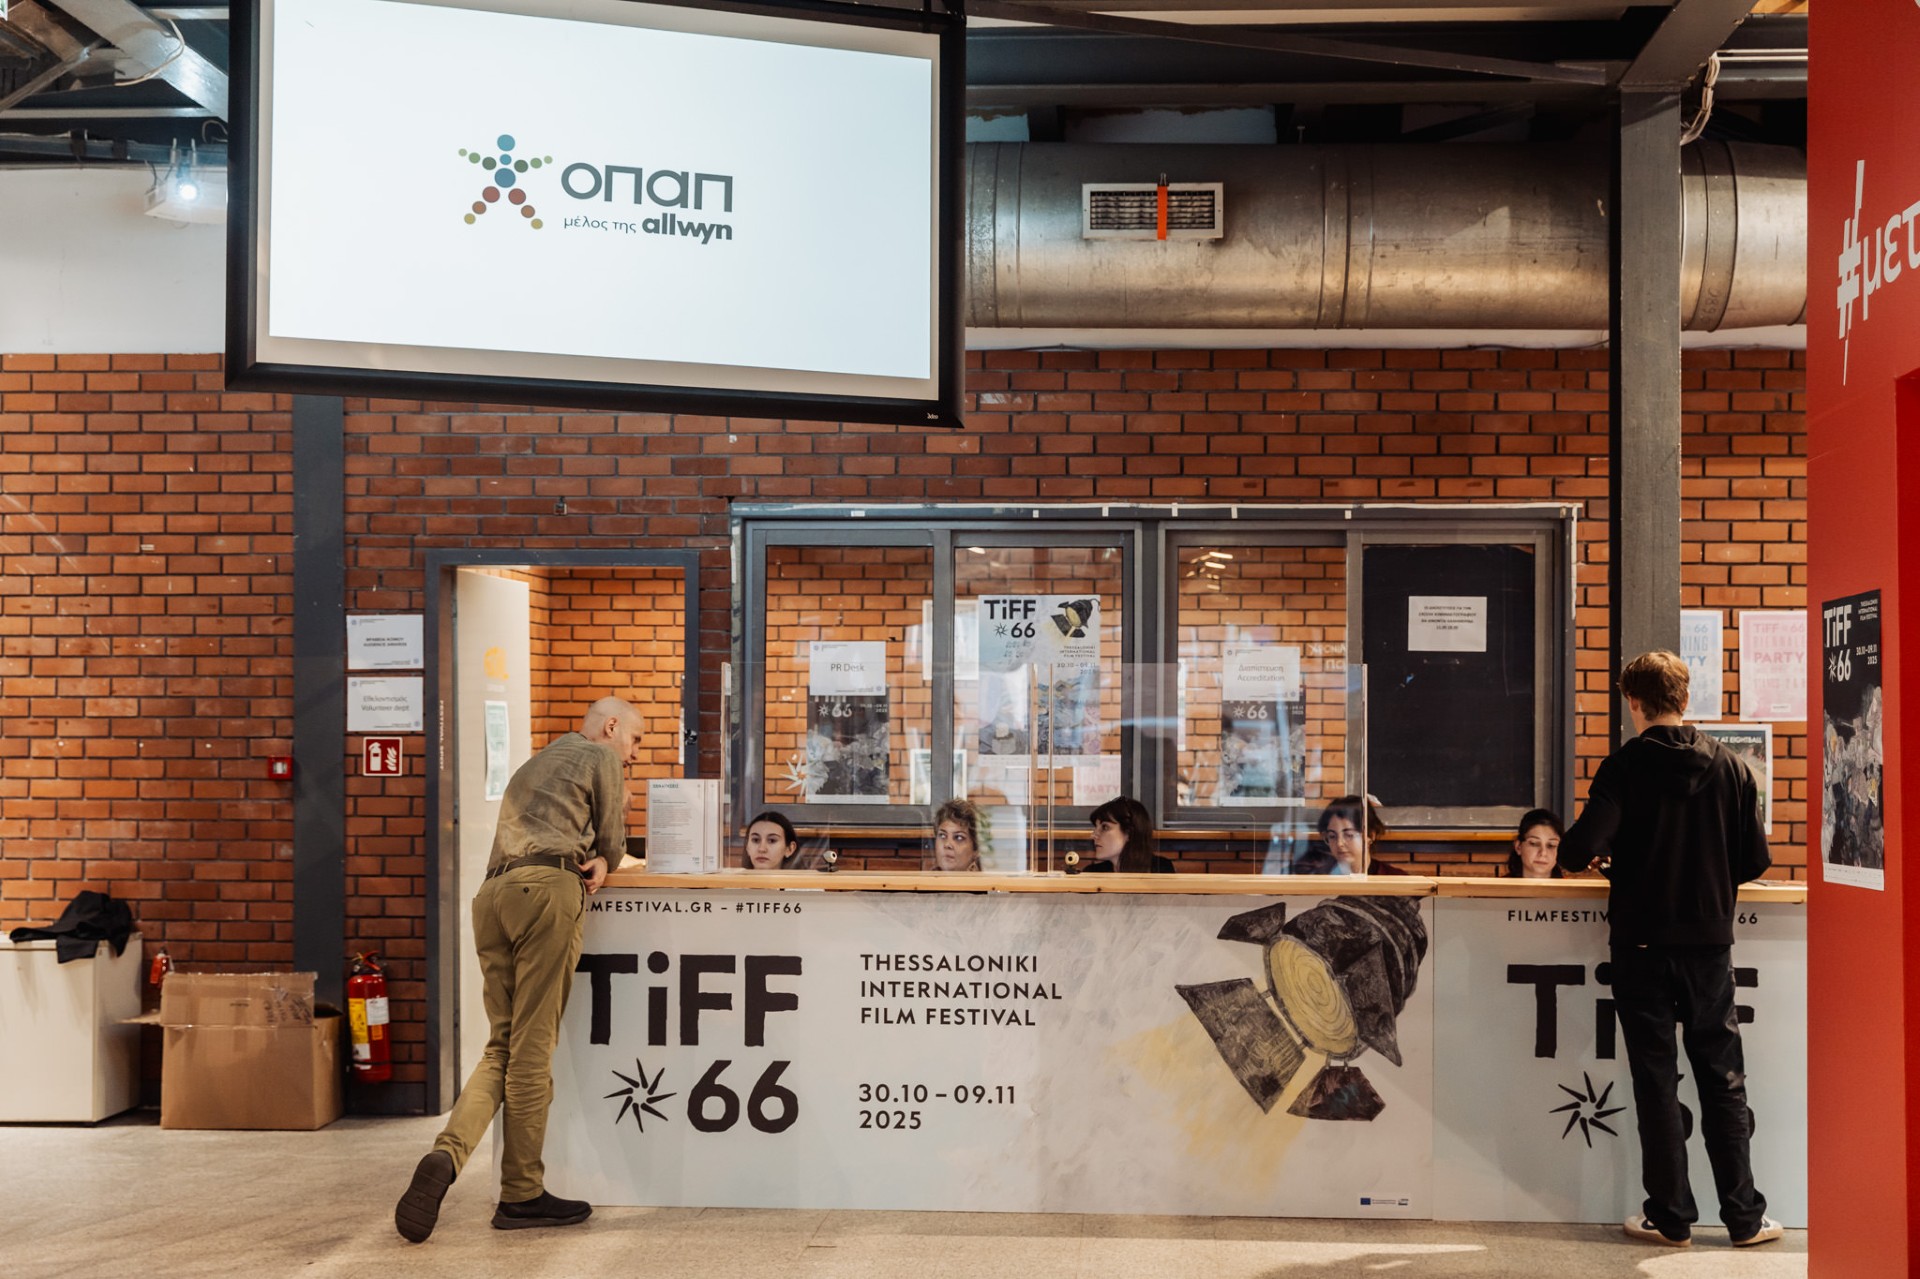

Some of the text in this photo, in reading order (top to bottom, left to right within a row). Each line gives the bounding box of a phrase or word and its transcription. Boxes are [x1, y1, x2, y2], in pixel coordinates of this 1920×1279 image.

[564, 212, 733, 245] μέλος της allwyn
[984, 600, 1036, 619] TiFF
[1011, 622, 1036, 638] 66
[1824, 604, 1852, 648] TiFF
[830, 663, 865, 672] PR Desk
[1754, 652, 1805, 664] PARTY
[1837, 649, 1852, 682] 66
[831, 704, 852, 717] 66
[1247, 705, 1268, 720] 66
[586, 901, 712, 913] MFESTIVAL.GR
[736, 902, 802, 914] #TIFF66
[860, 954, 1038, 972] THESSALONIKI
[575, 951, 802, 1047] TiFF
[861, 981, 1063, 1000] INTERNATIONAL
[861, 1007, 1037, 1026] FILM FESTIVAL
[687, 1060, 799, 1134] 66
[858, 1110, 922, 1129] 2025
